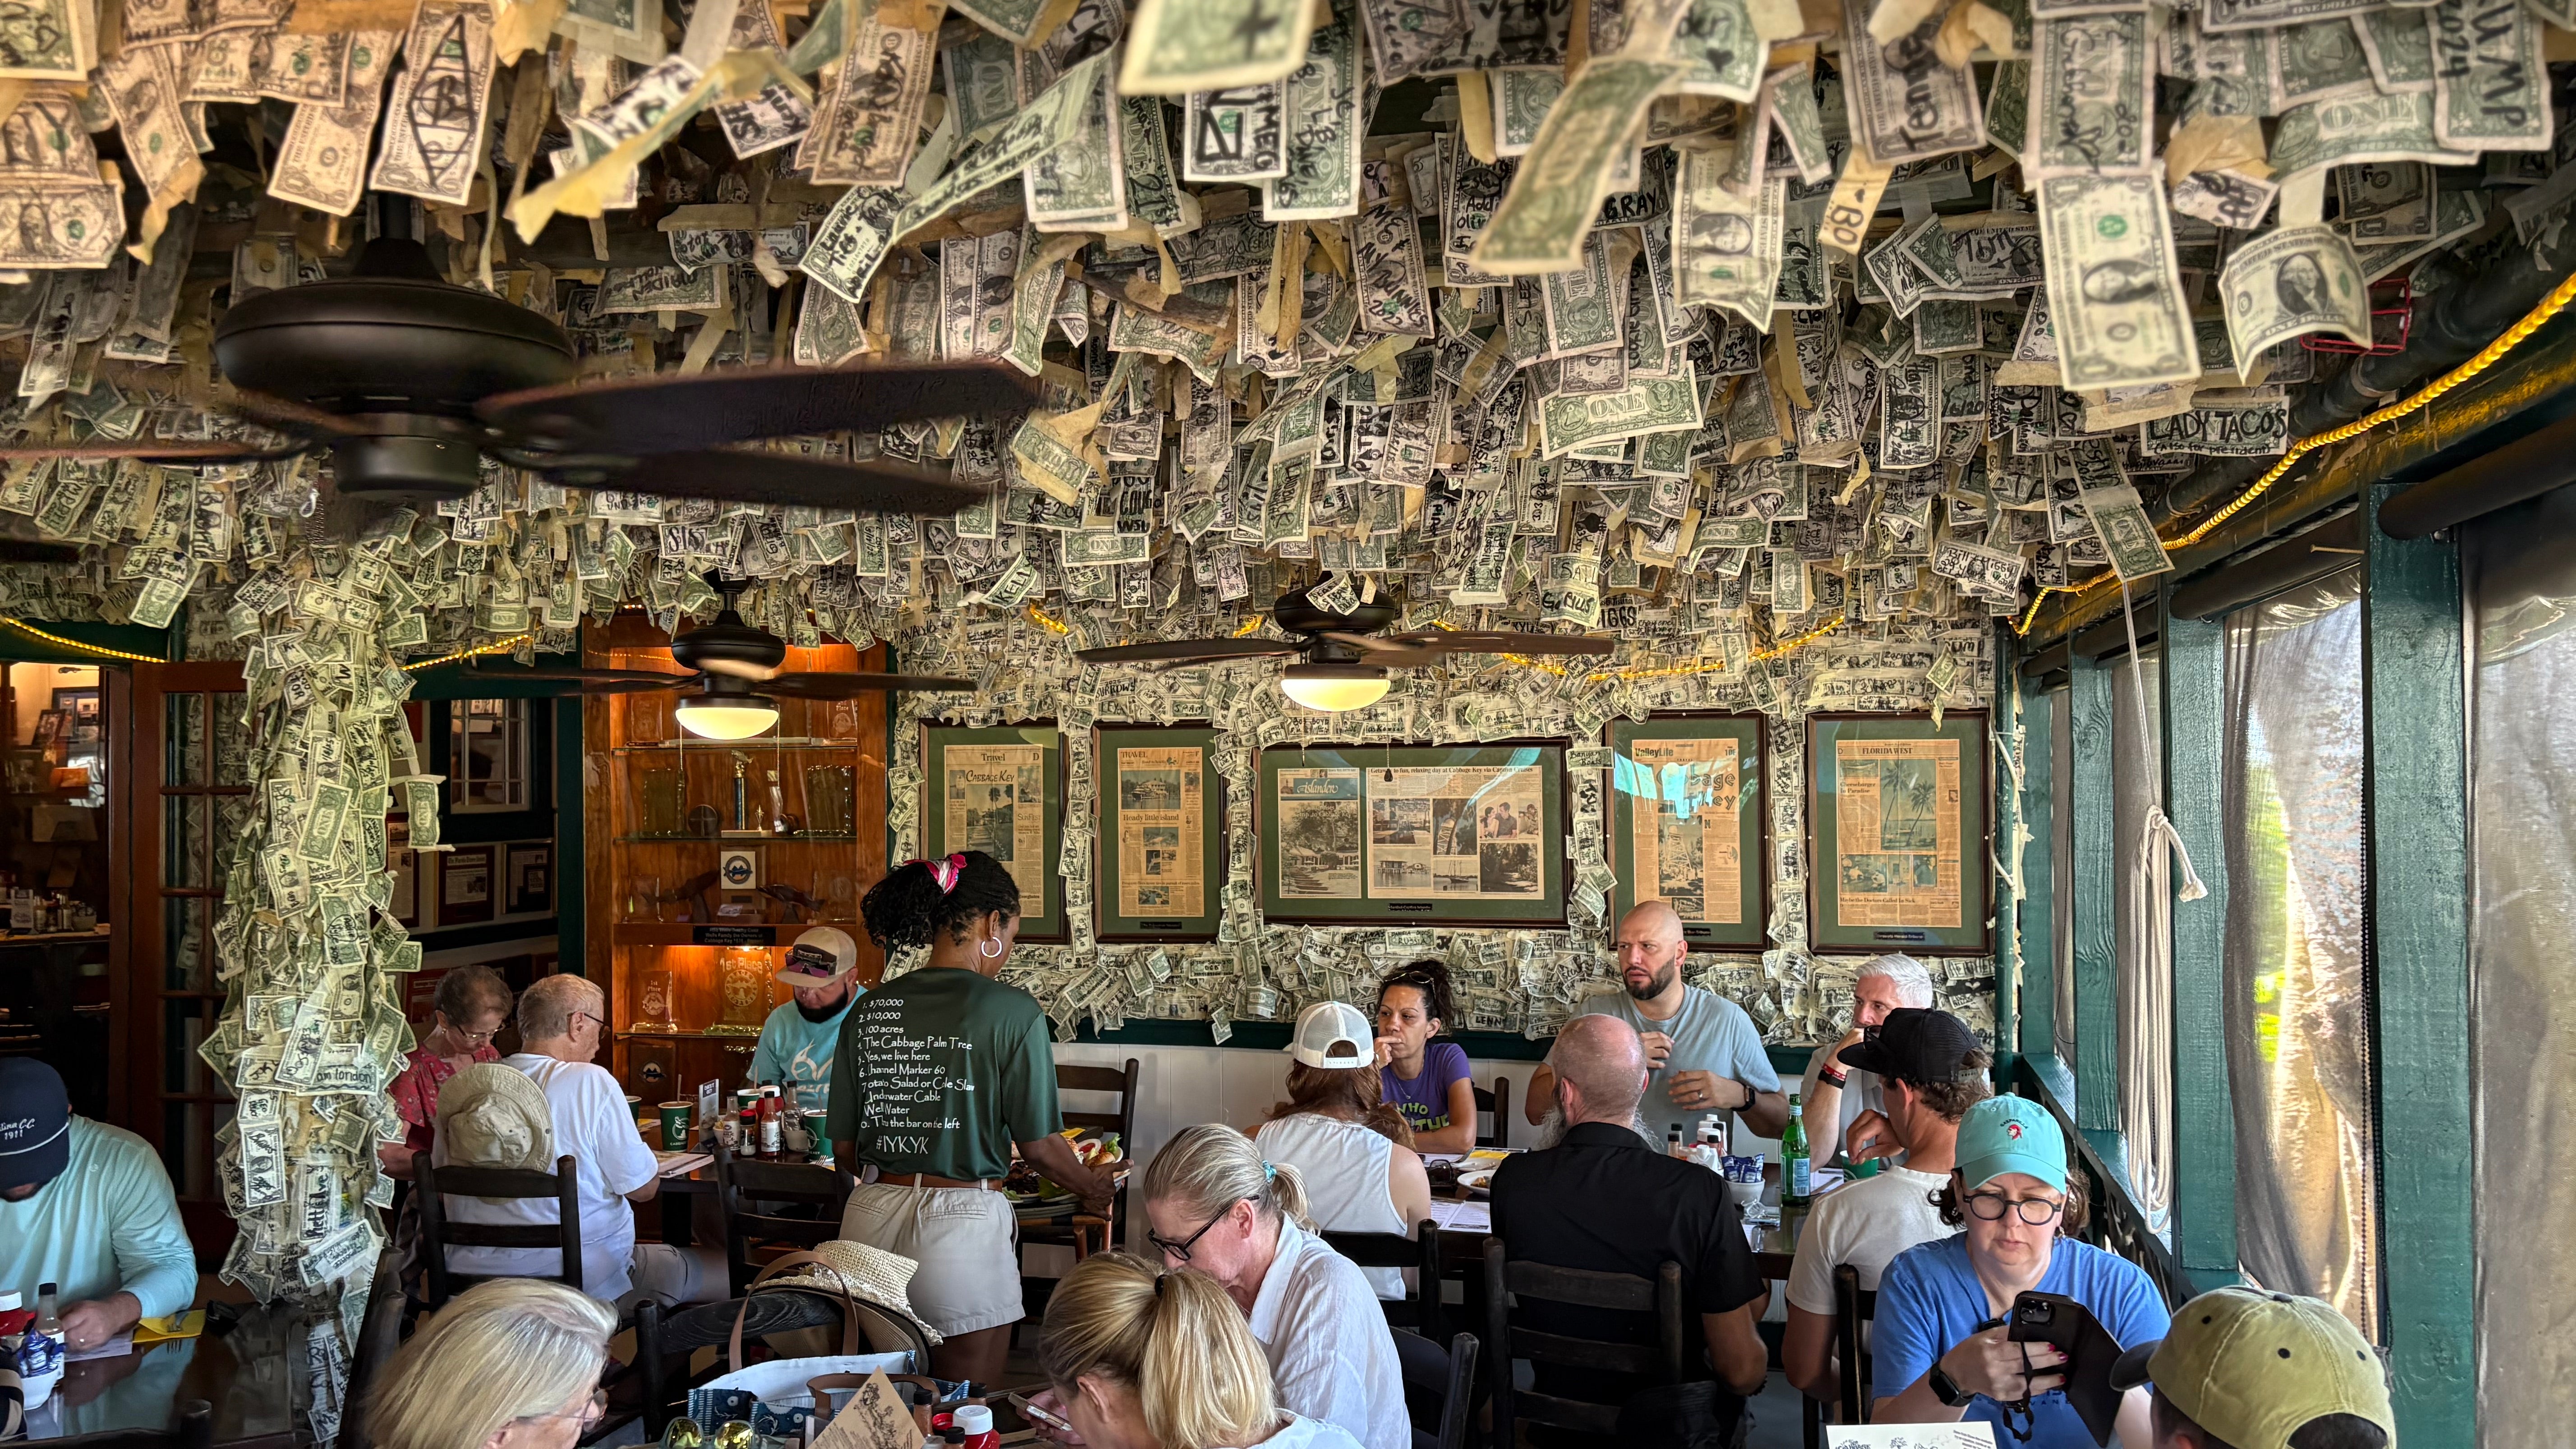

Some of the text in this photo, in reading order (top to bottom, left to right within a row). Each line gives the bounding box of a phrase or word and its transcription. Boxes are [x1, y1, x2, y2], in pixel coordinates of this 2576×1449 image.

[1590, 394, 1645, 417] ONE
[2149, 408, 2287, 442] LADY TACOS
[981, 752, 1040, 761] Travel D
[1635, 747, 1674, 758] ValleyLife
[1123, 814, 1143, 822] Heady
[737, 957, 763, 973] Place
[869, 999, 904, 1009] $70,000
[866, 1012, 901, 1020] $10,000
[865, 1025, 879, 1034] 100
[863, 1036, 972, 1050] The Cabbage Palm Tree
[865, 1050, 881, 1062] Yes,
[894, 1050, 910, 1061] live
[911, 1050, 931, 1061] here
[899, 1063, 932, 1076] Marker
[934, 1065, 946, 1074] 60
[890, 1077, 919, 1089] Salad
[932, 1077, 953, 1089] Cole
[914, 1090, 941, 1103] Cable
[890, 1116, 905, 1127] the
[906, 1116, 921, 1128] bar
[944, 1118, 961, 1129] left
[5, 1129, 23, 1140] 1911
[875, 1135, 929, 1155] #IYKYK
